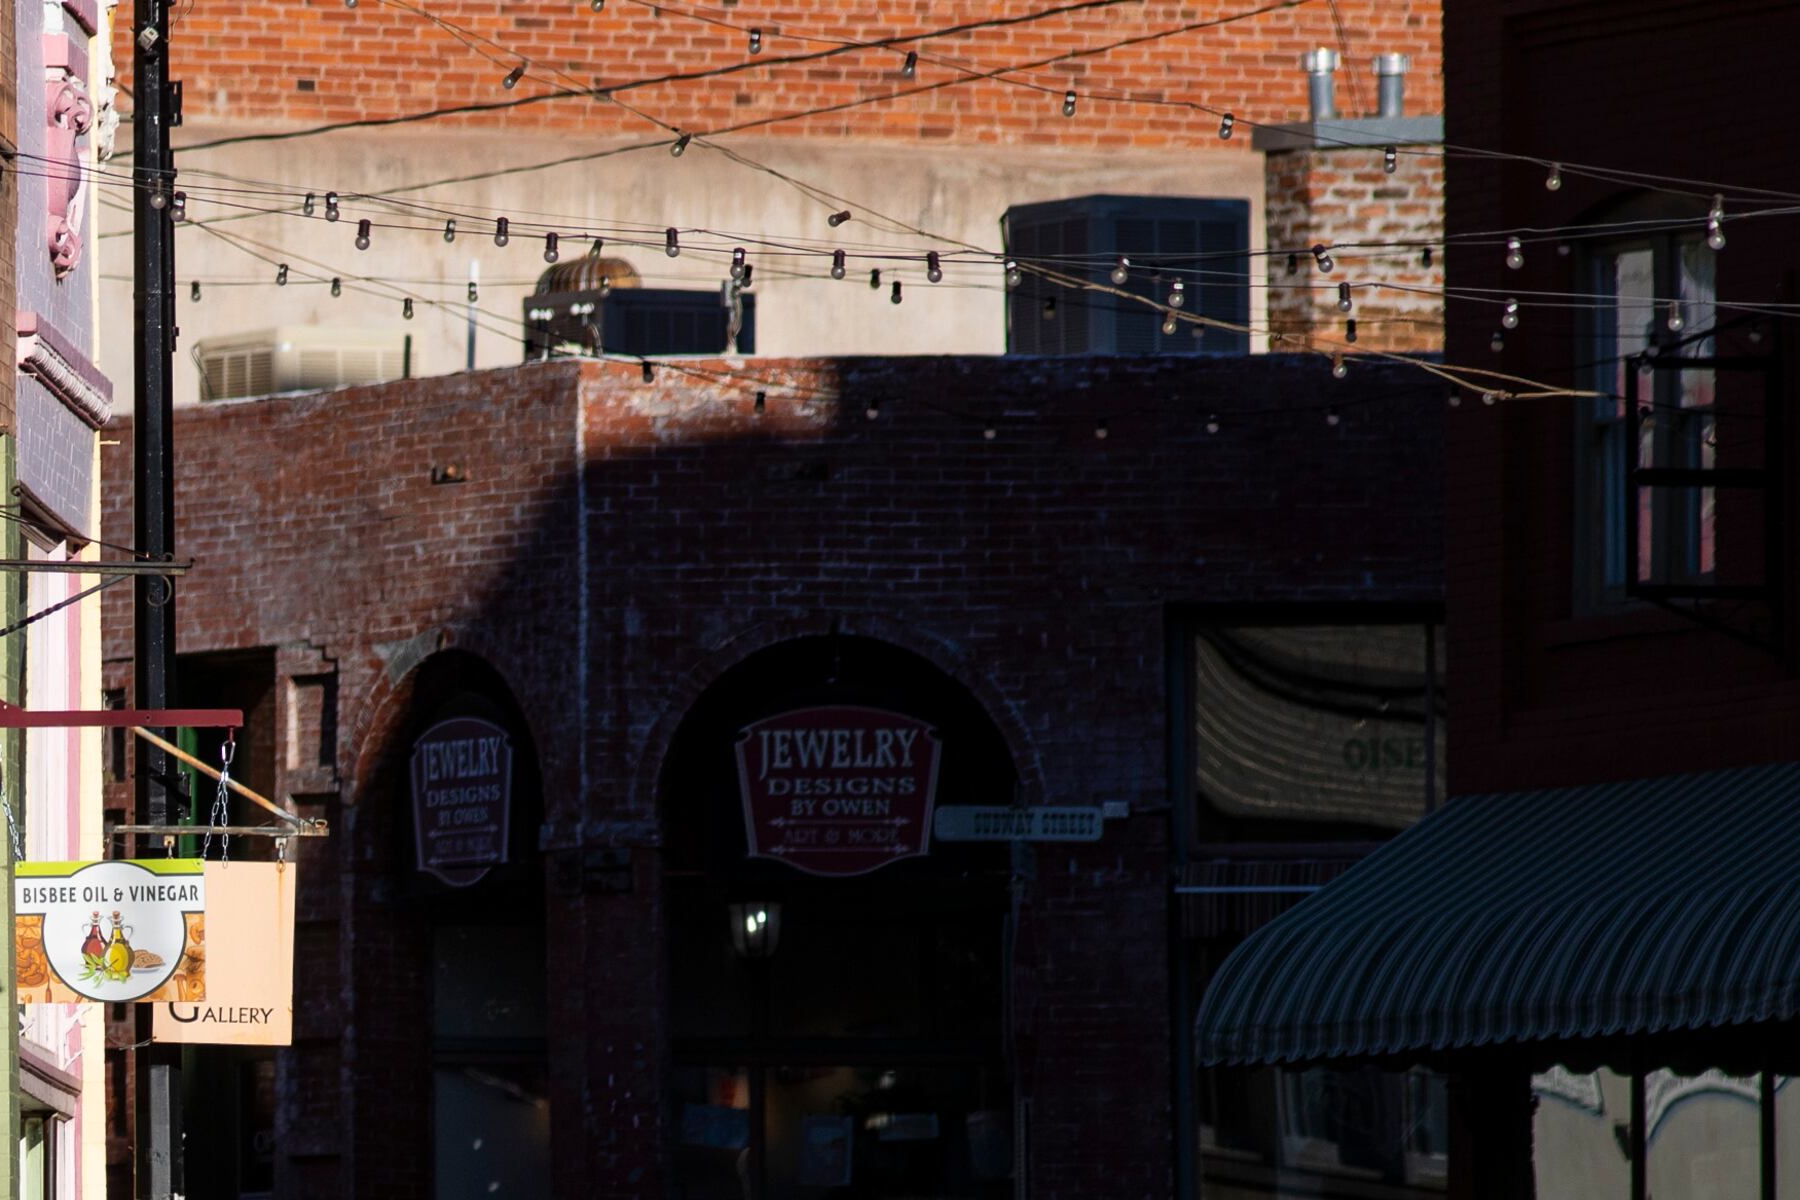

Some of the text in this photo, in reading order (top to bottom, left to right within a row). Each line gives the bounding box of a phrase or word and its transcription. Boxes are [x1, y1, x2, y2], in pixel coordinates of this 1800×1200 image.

[422, 736, 502, 793] JEWELRY
[759, 728, 920, 781] JEWELRY
[426, 784, 502, 807] DESIGNS
[766, 777, 917, 796] DESIGNS
[791, 799, 891, 817] BY OWEN
[1042, 812, 1095, 836] STREET
[22, 884, 199, 904] BISBEE OIL & VINEGAR
